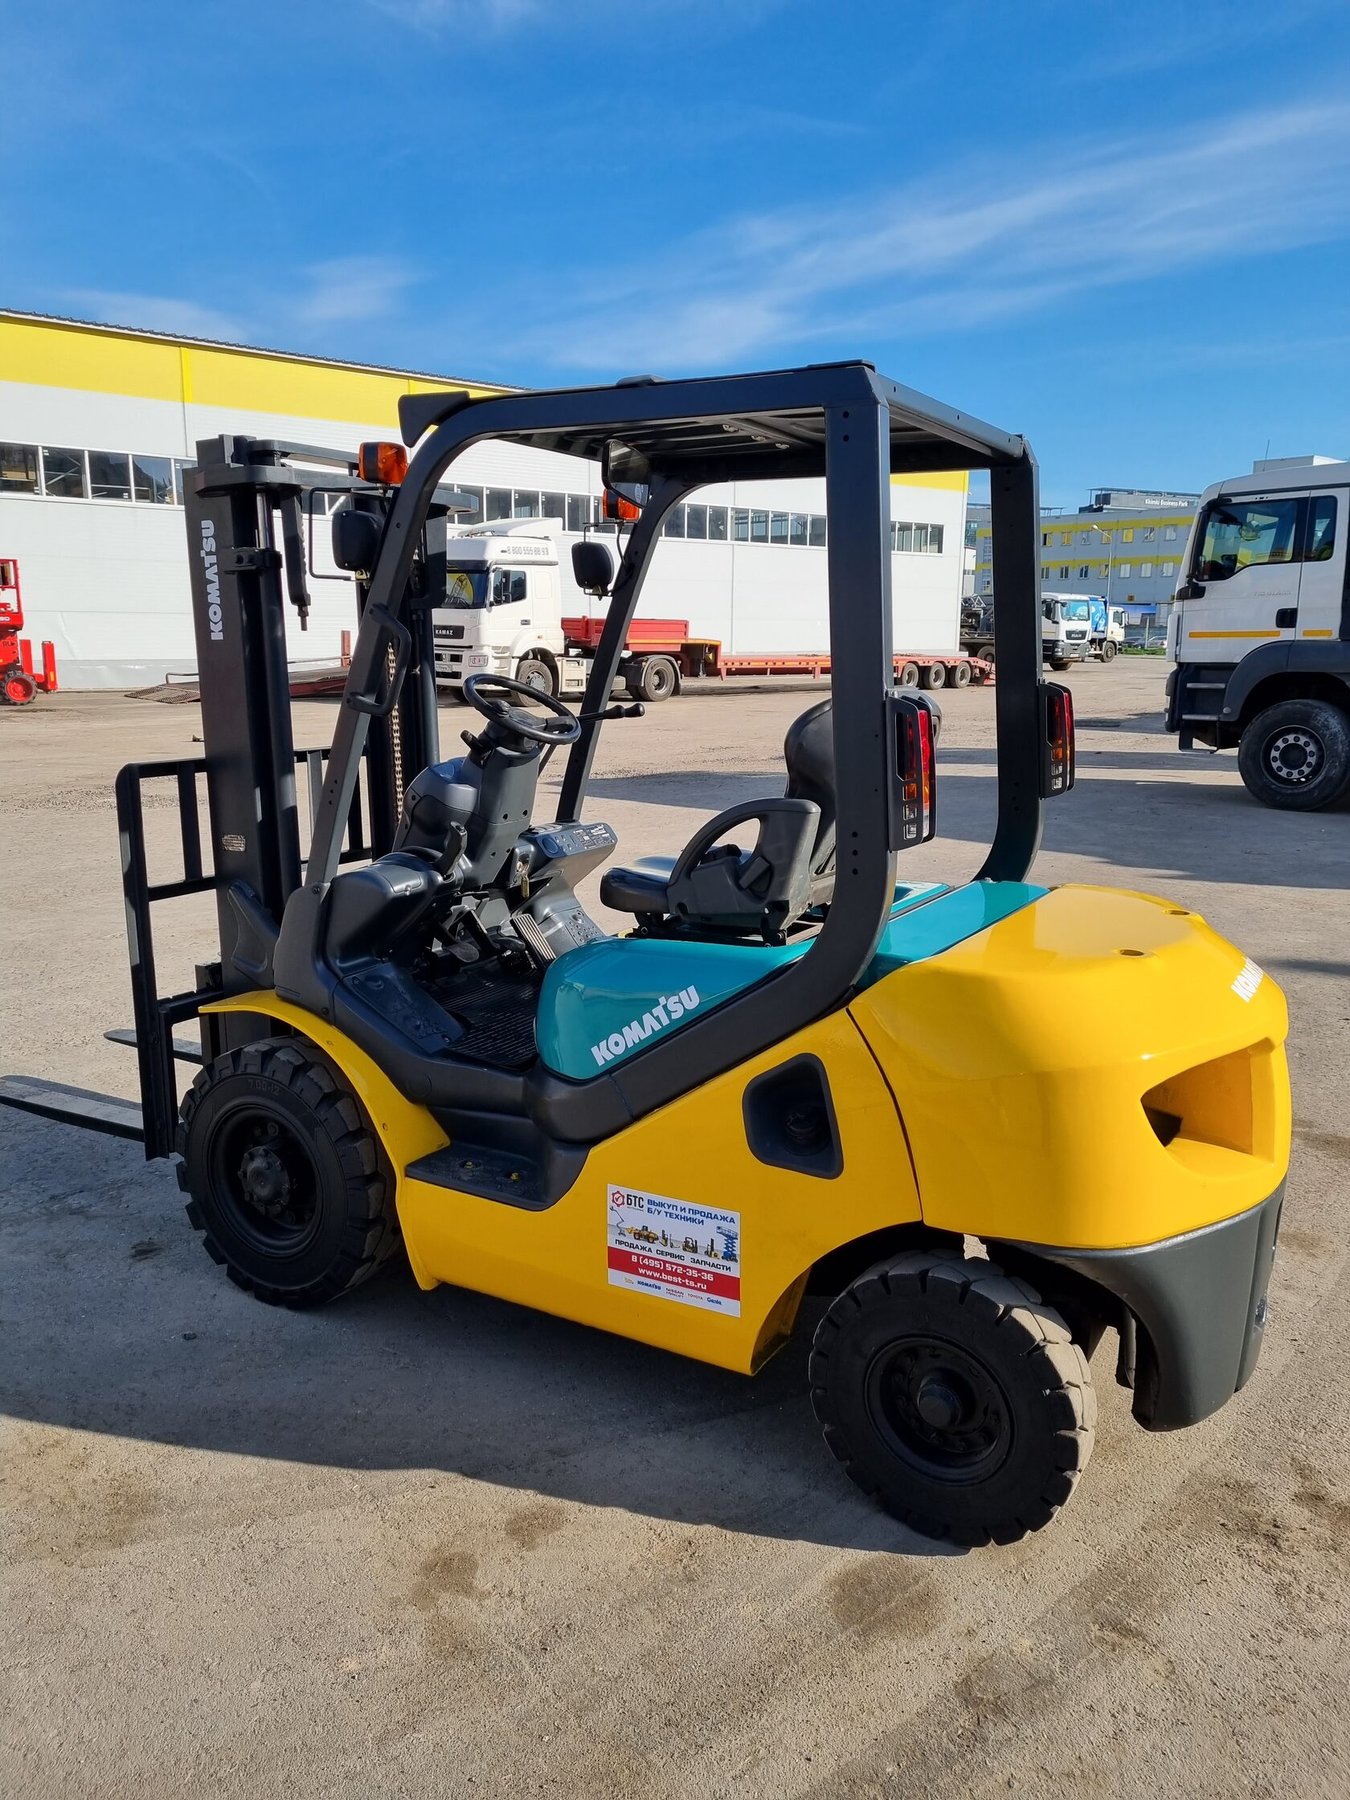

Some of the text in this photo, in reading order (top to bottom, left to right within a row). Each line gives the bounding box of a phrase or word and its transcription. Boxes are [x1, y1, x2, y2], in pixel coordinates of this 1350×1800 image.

[200, 520, 224, 640] KOMATSU
[591, 985, 700, 1067] KOMATSU
[626, 1194, 644, 1209] БТС
[647, 1199, 678, 1212] ВЫКУП
[688, 1208, 736, 1224] ПРОДАЖА
[647, 1207, 662, 1216] Б/У
[664, 1211, 704, 1226] ТЕХНИКИ
[615, 1239, 732, 1272] ПРОДАЖА СЕРВИС ЗАПЧАСТИ
[638, 1268, 707, 1290] www.best-ts.ru
[639, 1256, 664, 1270] (495)
[665, 1263, 714, 1281] 572-35-36
